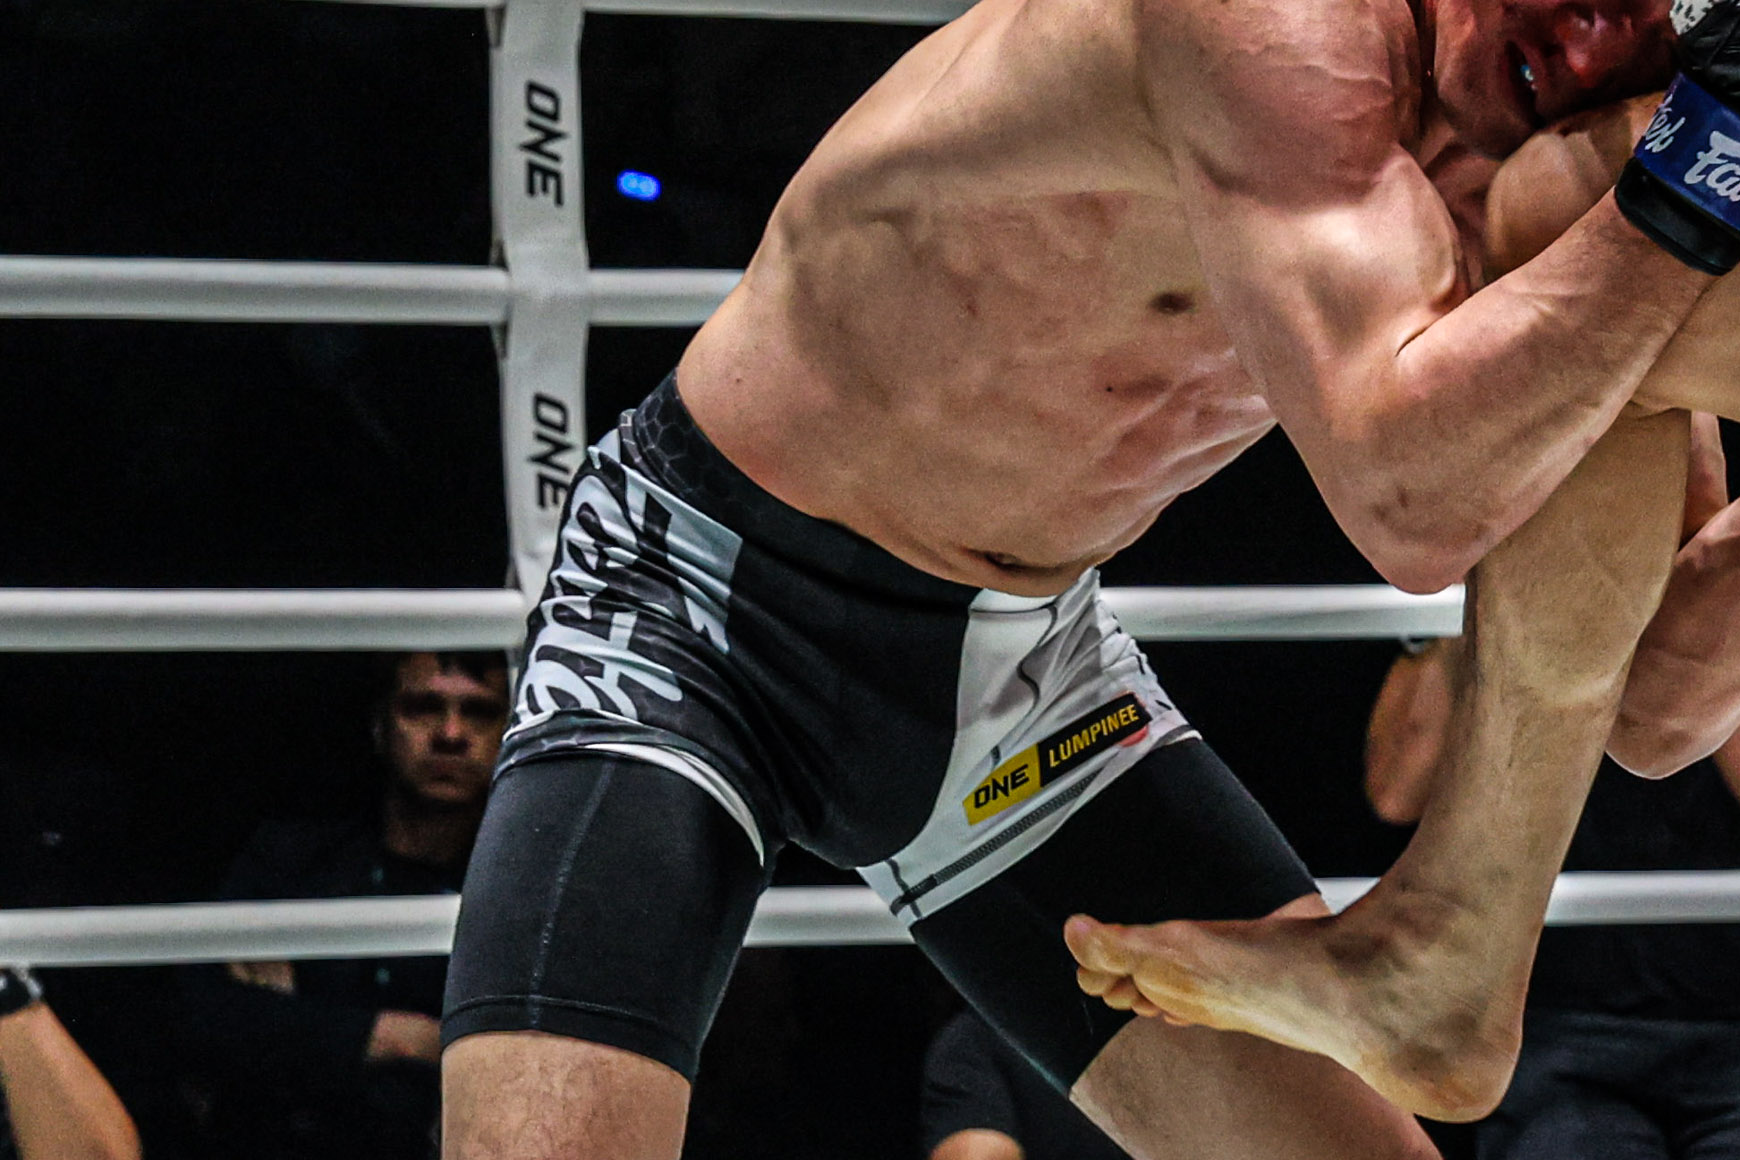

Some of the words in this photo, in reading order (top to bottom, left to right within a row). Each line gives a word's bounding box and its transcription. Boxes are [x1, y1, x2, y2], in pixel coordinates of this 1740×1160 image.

[519, 80, 570, 209] ONE
[529, 391, 575, 510] ONE
[973, 763, 1030, 809] ONE
[1049, 703, 1140, 768] LUMPINEE
